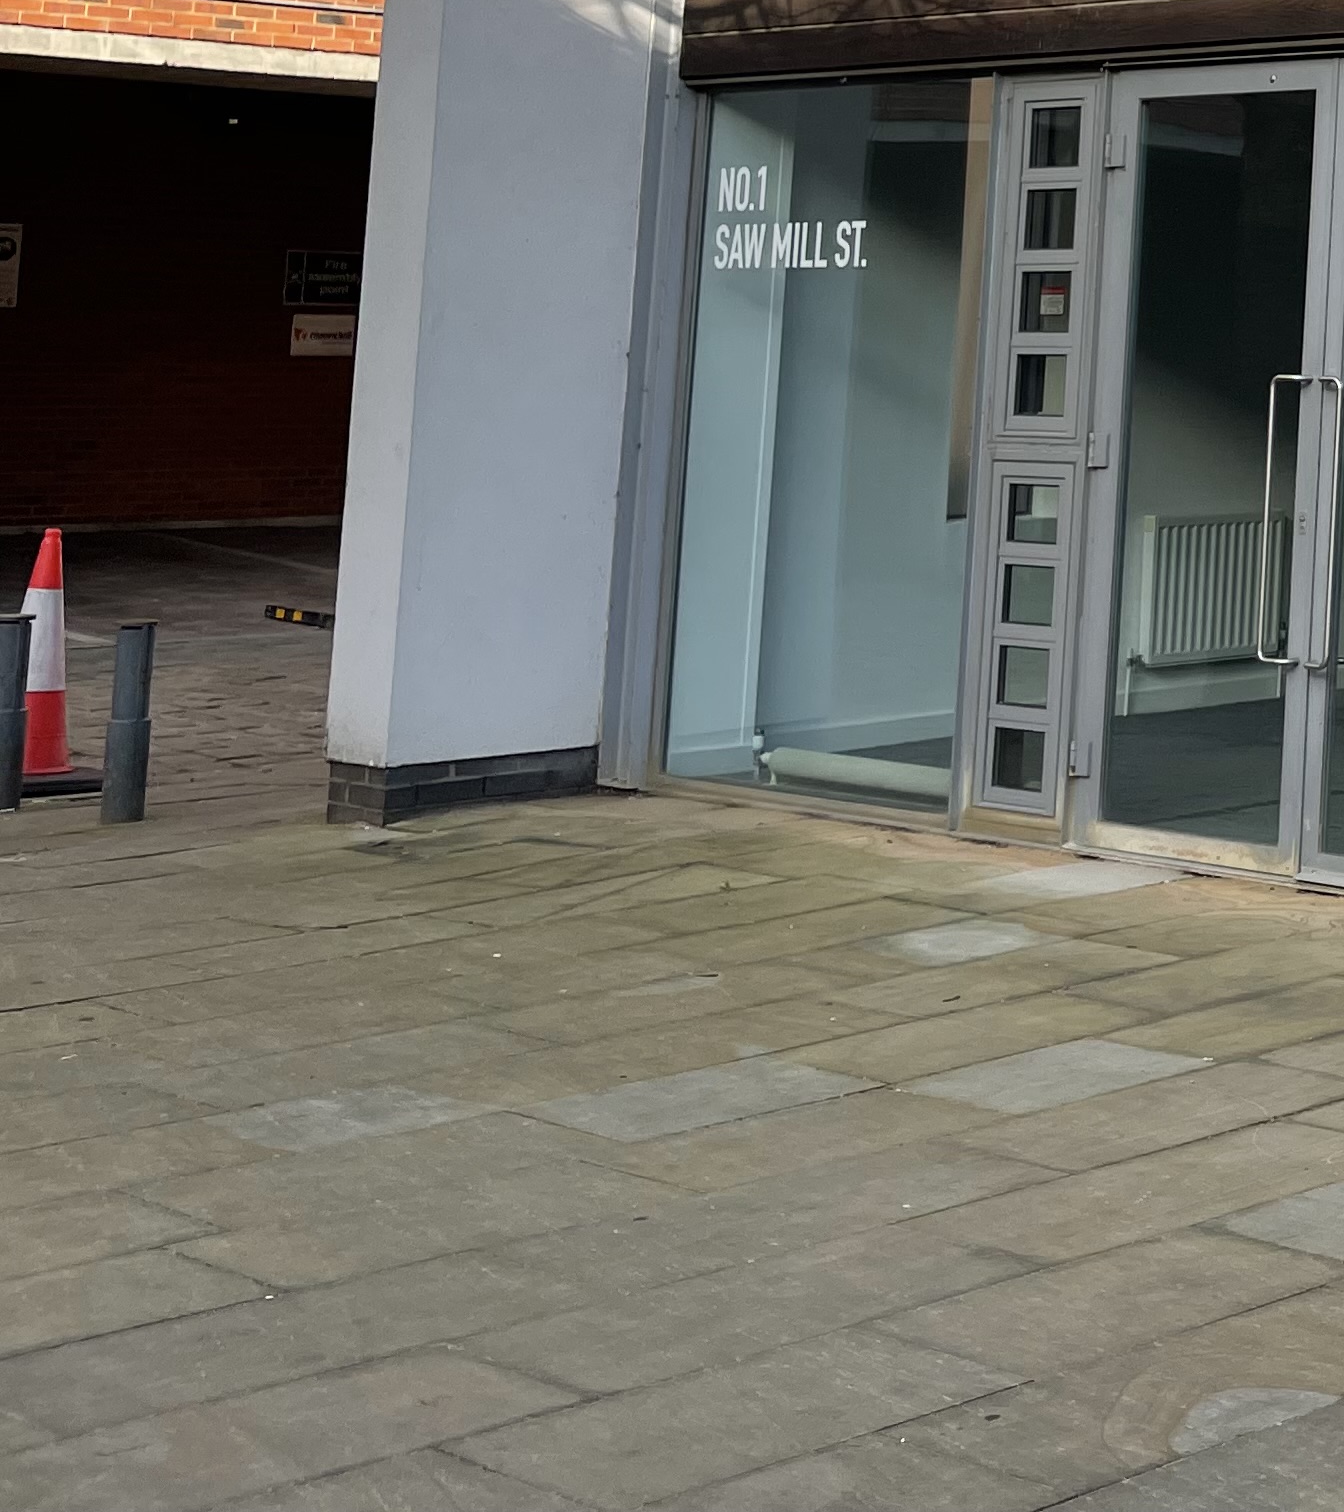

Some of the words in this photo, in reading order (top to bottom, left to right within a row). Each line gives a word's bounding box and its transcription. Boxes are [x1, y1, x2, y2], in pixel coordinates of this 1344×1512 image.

[718, 165, 768, 212] NO.1
[713, 223, 767, 270] SAW
[770, 222, 828, 269] MILL
[834, 220, 867, 268] ST.
